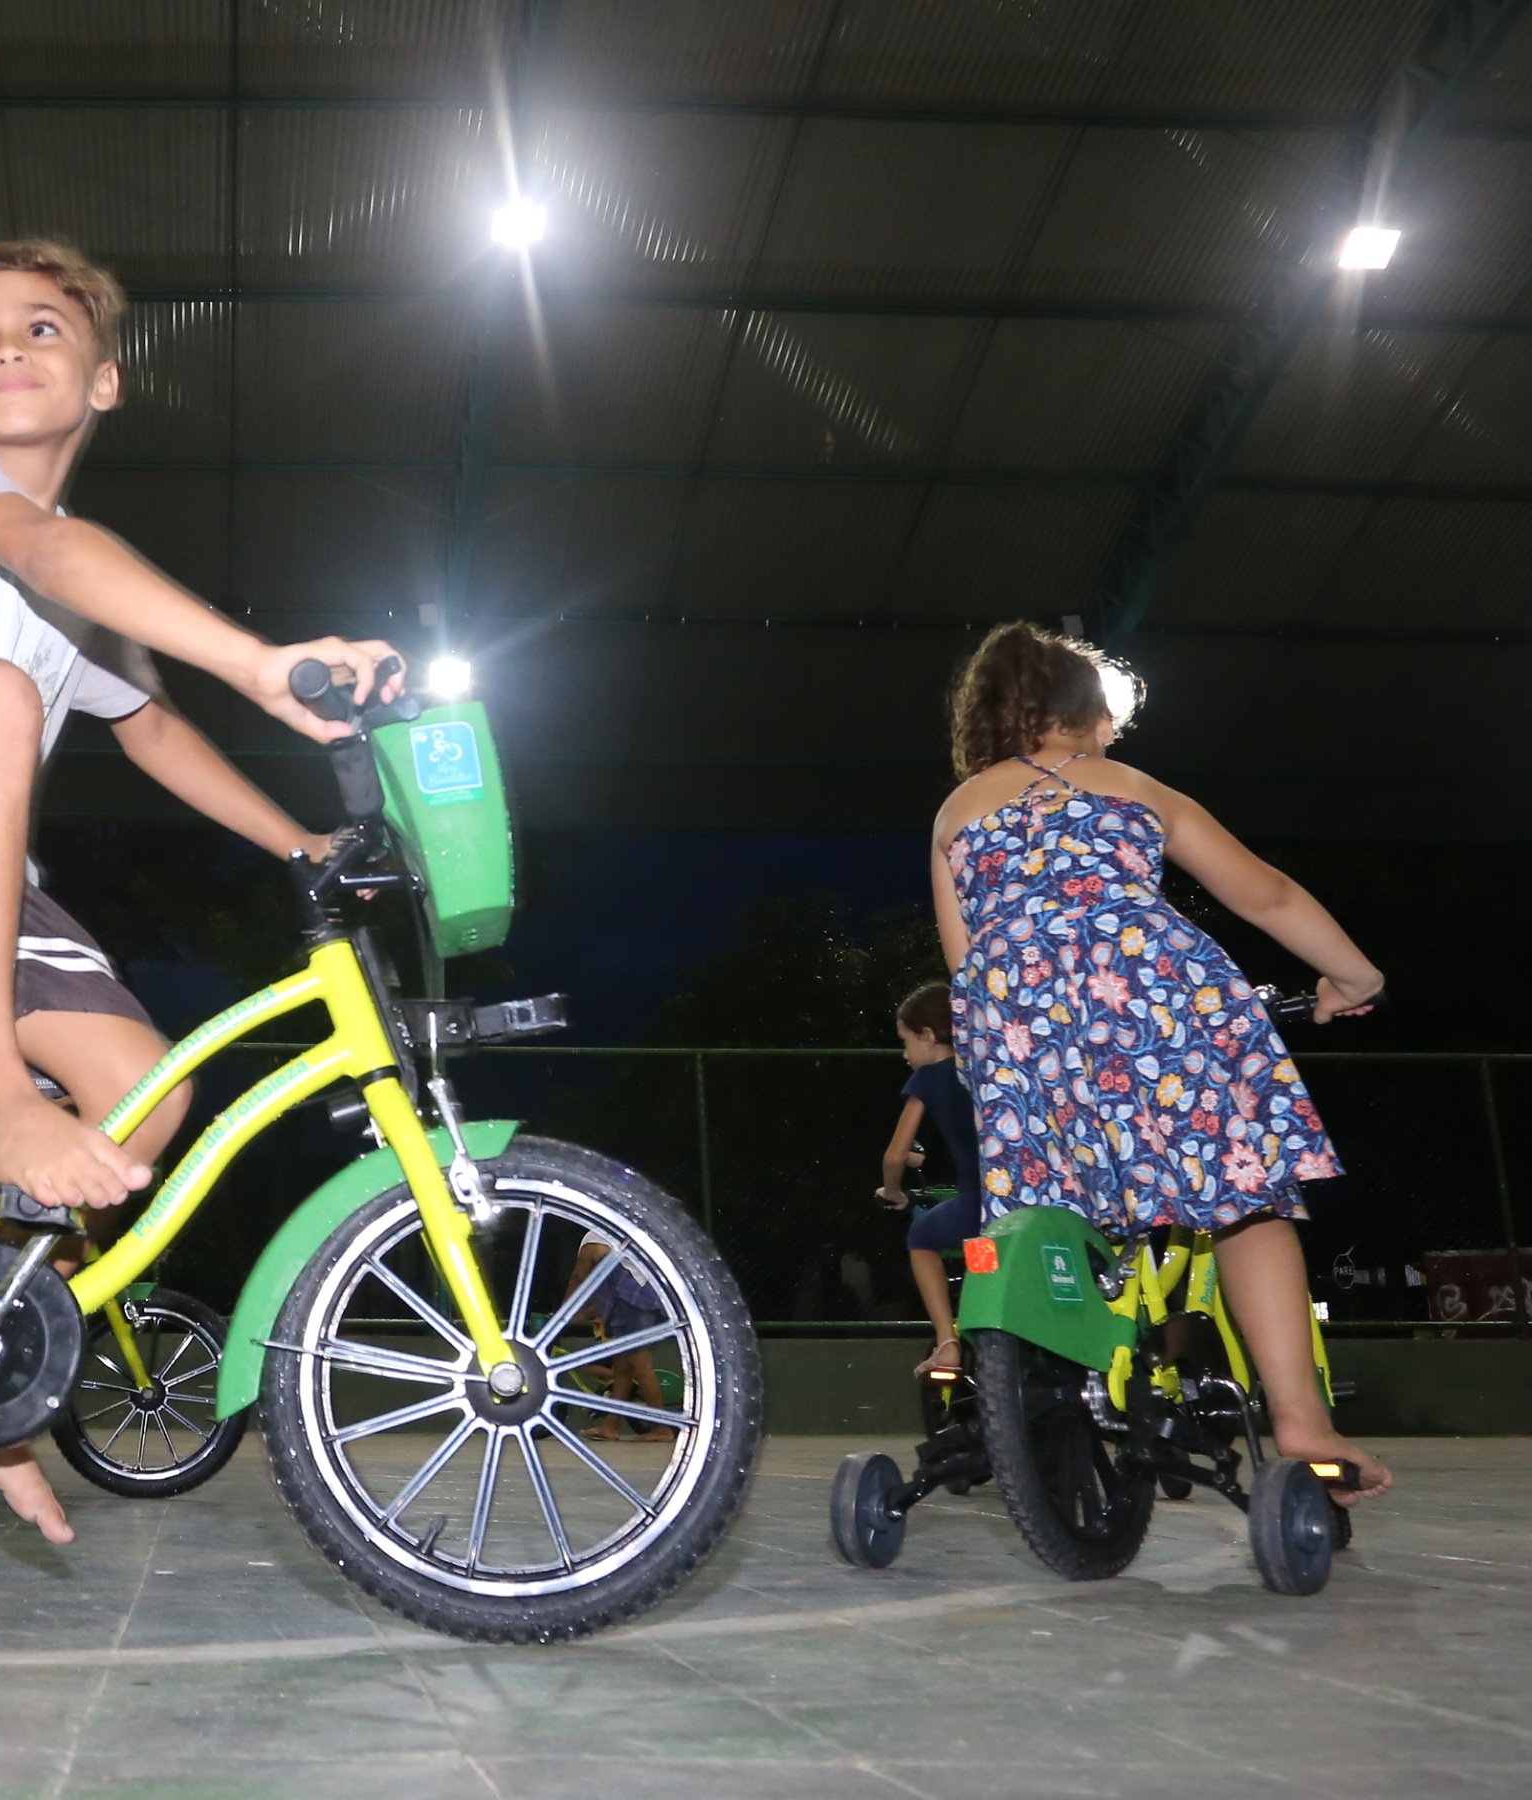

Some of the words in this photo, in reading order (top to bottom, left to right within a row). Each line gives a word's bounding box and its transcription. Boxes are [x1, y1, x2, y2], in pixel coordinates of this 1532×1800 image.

[168, 989, 275, 1061] Fortaleza
[132, 1151, 204, 1237] Prefeitura
[203, 1127, 226, 1149] de
[224, 1061, 309, 1126] Fortaleza
[1333, 1266, 1354, 1276] PARE
